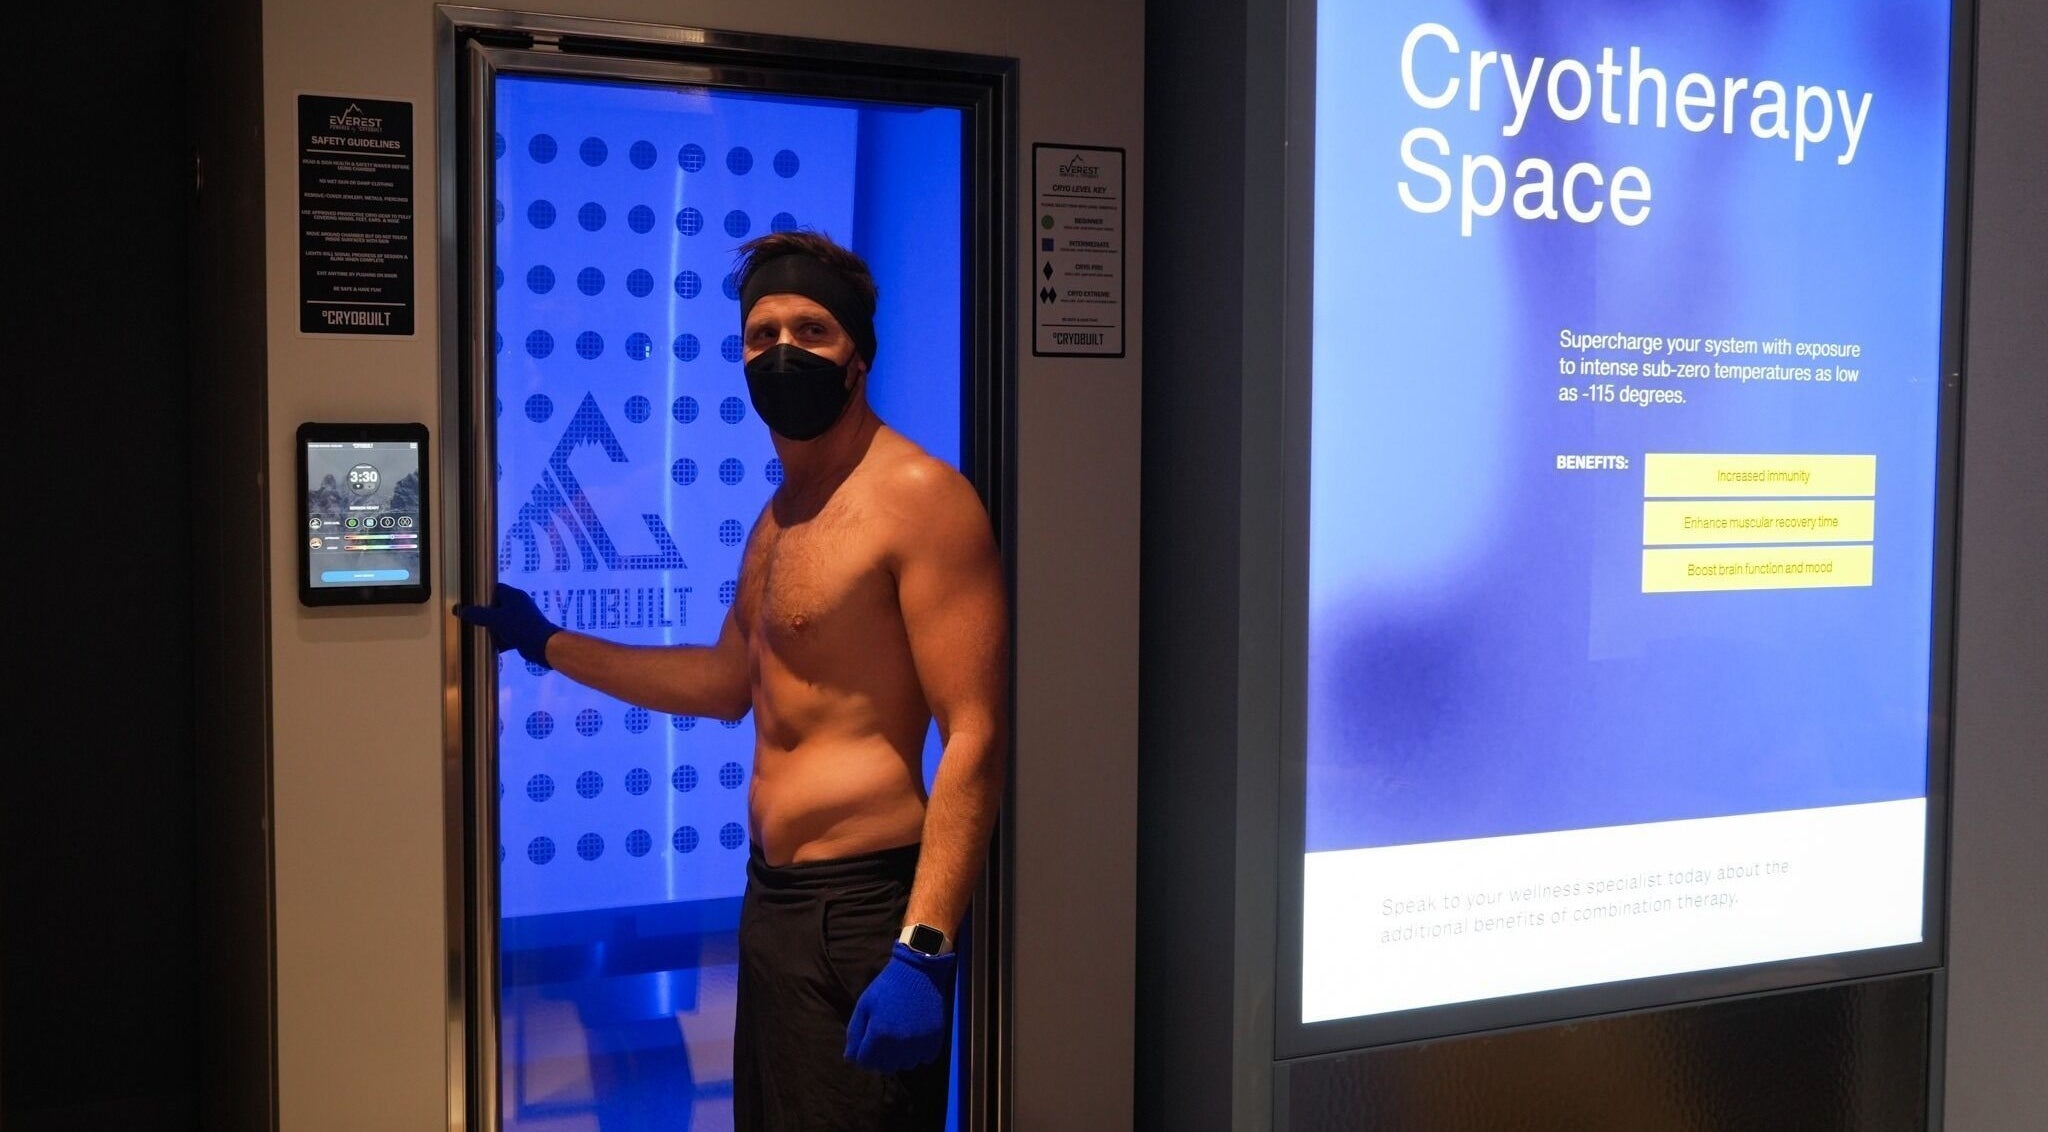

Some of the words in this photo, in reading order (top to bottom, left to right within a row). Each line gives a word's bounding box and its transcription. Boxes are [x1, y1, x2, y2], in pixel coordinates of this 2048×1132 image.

[1400, 22, 1872, 165] Cryotherapy
[330, 116, 382, 127] EVEREST
[312, 136, 346, 146] SAFETY
[348, 138, 400, 150] GUIDELINES
[1060, 164, 1100, 175] EVEREST
[1052, 184, 1070, 192] CRYO
[1072, 185, 1092, 193] LEVEL
[1397, 127, 1651, 236] Space
[1560, 330, 1662, 356] Supercharge
[1666, 337, 1702, 356] your
[1704, 338, 1758, 354] system
[1762, 338, 1792, 354] with
[1796, 342, 1860, 360] exposure
[1560, 358, 1576, 375] to
[1580, 358, 1638, 376] intense
[1642, 360, 1710, 378] sub-zero
[1714, 362, 1812, 383] temperatures
[1815, 368, 1832, 382] as
[1836, 366, 1859, 382] low
[1559, 389, 1578, 402] as
[1582, 385, 1614, 402] -115
[1620, 386, 1686, 407] degrees.
[1557, 455, 1629, 470] BENEFITS:
[350, 471, 378, 483] 3:30
[1717, 469, 1765, 482] Increased
[1767, 470, 1810, 484] immunity
[1684, 516, 1727, 529] Enhance
[1729, 516, 1773, 528] muscular
[1775, 516, 1817, 530] recovery
[1817, 516, 1838, 527] time
[1688, 564, 1717, 576] Boost
[1718, 563, 1743, 576] brain
[1745, 562, 1784, 575] function
[1785, 562, 1803, 574] and
[1805, 561, 1833, 573] mood
[1382, 897, 1436, 916] Speak
[1443, 895, 1460, 910] to
[1467, 890, 1503, 910] your
[1508, 882, 1580, 904] wellness
[1586, 873, 1662, 896] specialist
[1668, 868, 1711, 890] today
[1717, 862, 1760, 882] about
[1765, 859, 1790, 876] the
[1380, 921, 1468, 944] additional
[1473, 911, 1545, 933] benefits
[1550, 908, 1568, 924] of
[1573, 898, 1672, 922] combination
[1677, 890, 1739, 914] therapy.
